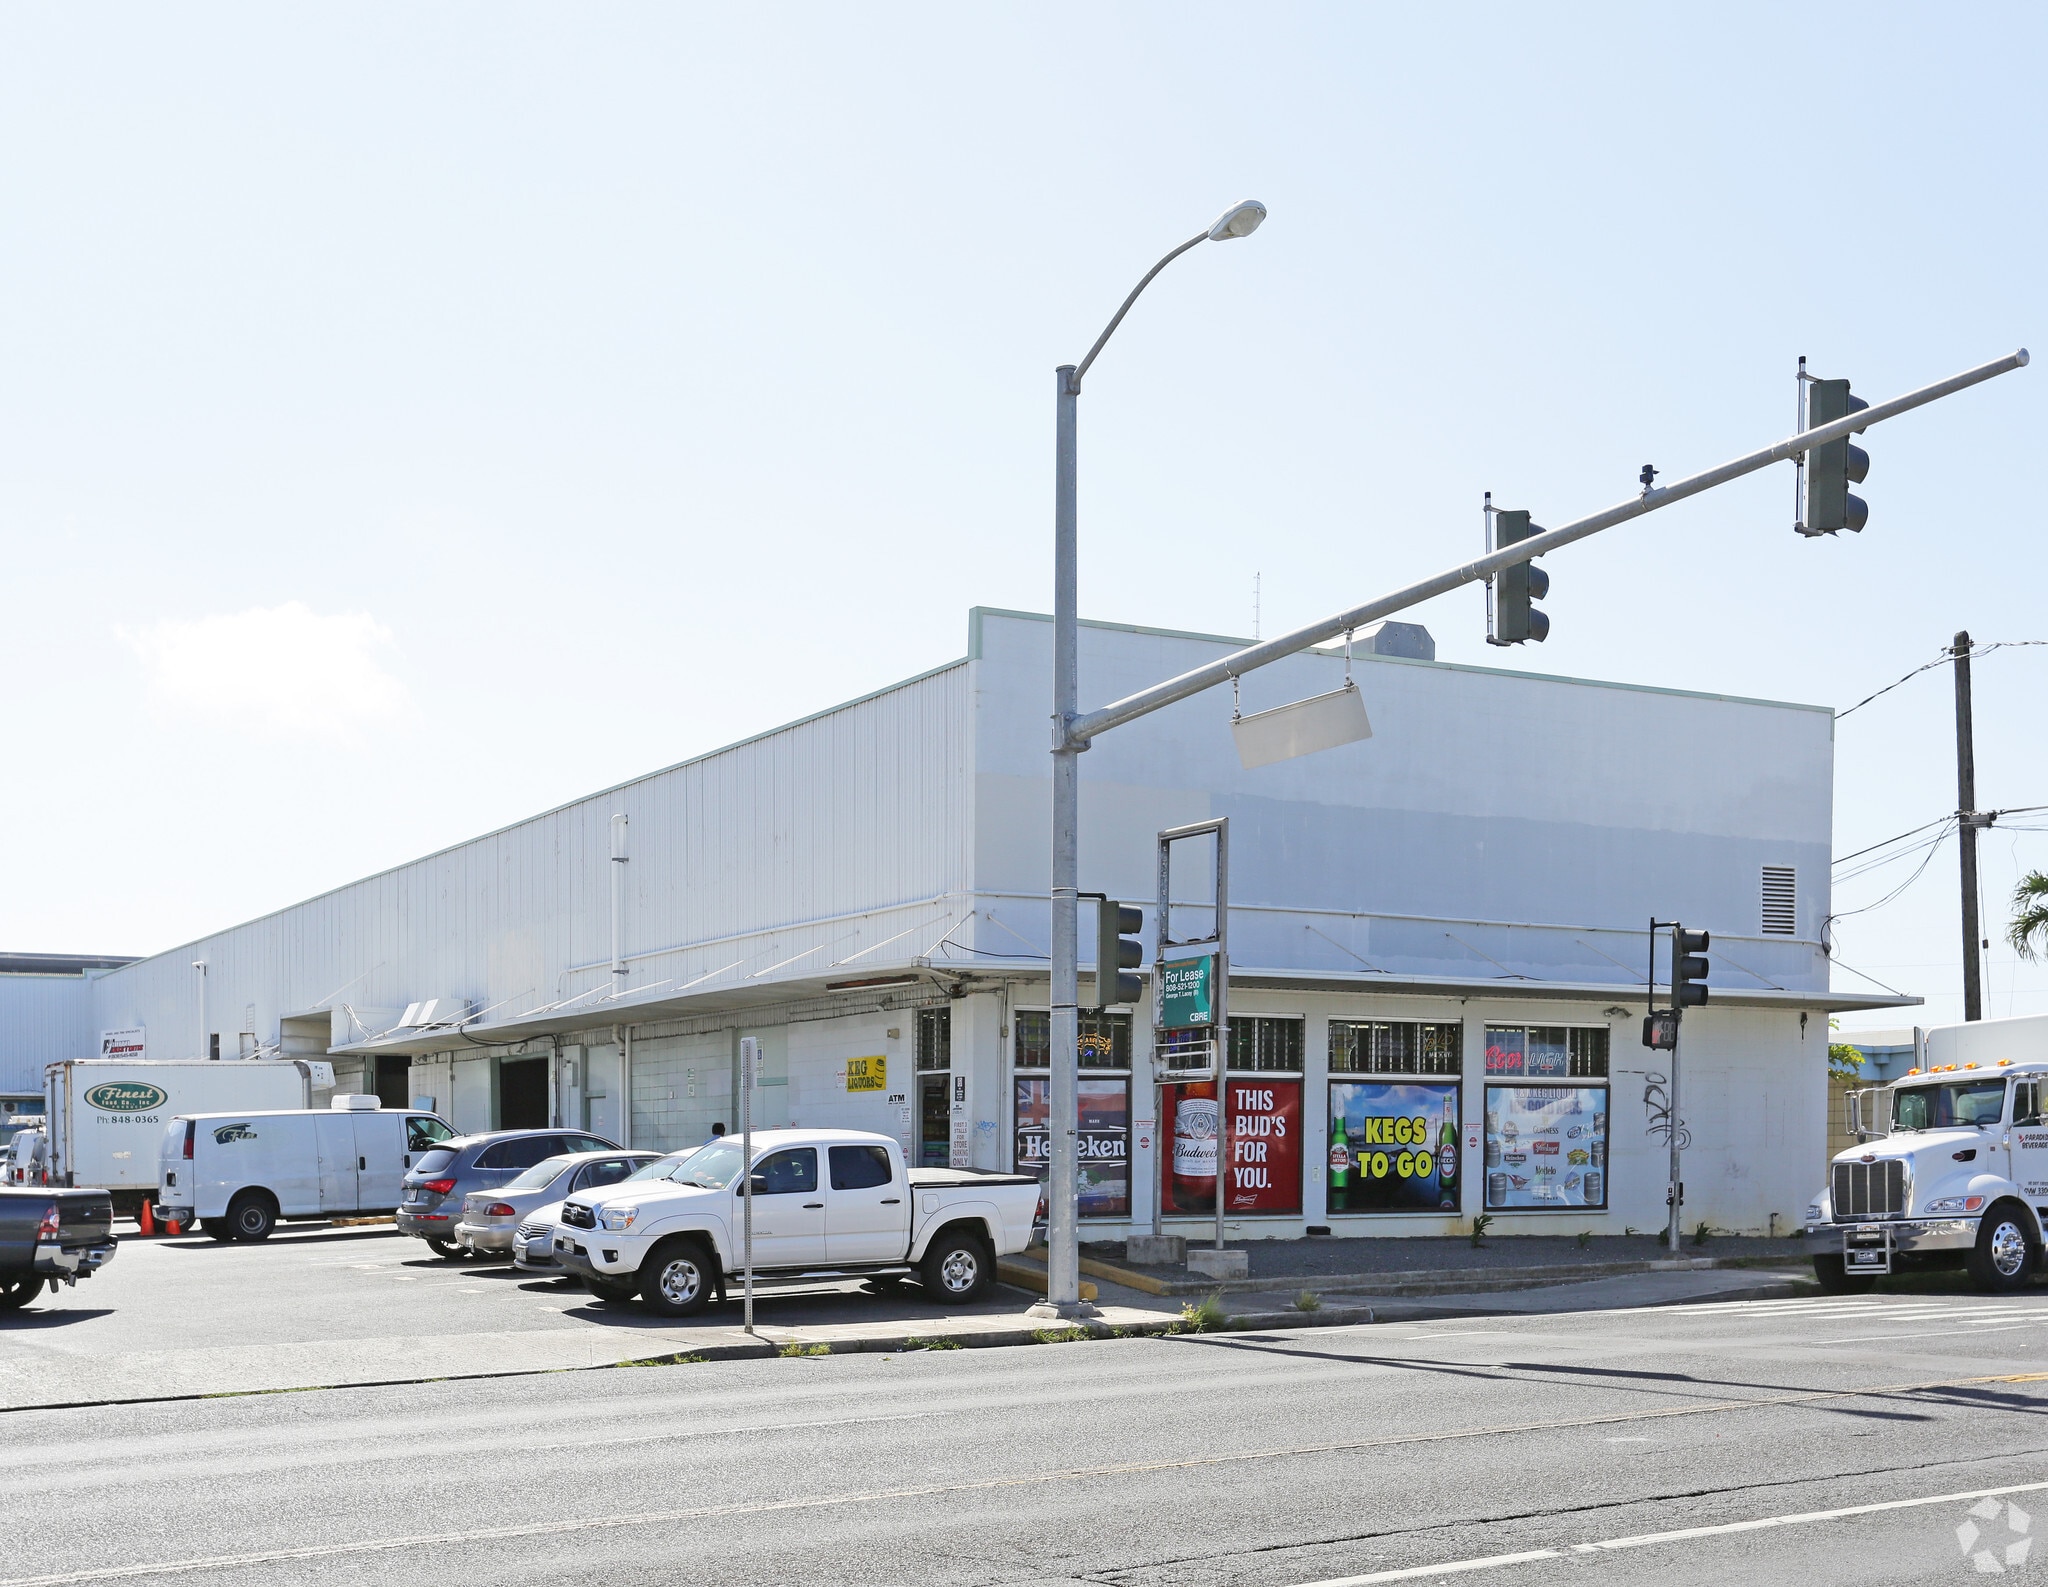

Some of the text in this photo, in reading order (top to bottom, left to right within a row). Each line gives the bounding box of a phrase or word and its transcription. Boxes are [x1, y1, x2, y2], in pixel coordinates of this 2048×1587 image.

[1165, 969, 1204, 984] For Lease
[1165, 980, 1200, 992] 808-521-1200
[1190, 1011, 1208, 1022] CBRE
[1485, 1045, 1523, 1069] Coor
[848, 1060, 868, 1076] KEG
[848, 1076, 875, 1089] LIQUORS
[98, 1087, 153, 1100] Finest
[888, 1094, 905, 1102] ATM
[1235, 1089, 1274, 1111] THIS
[1550, 1088, 1577, 1100] LIQUOR
[111, 1115, 159, 1124] 848-0365
[1235, 1115, 1286, 1137] BUD'S
[1365, 1116, 1427, 1144] KEGS
[1532, 1126, 1559, 1135] GUINNESS
[953, 1141, 968, 1149] STORE
[1025, 1135, 1126, 1157] Heeken
[1234, 1141, 1267, 1162] FOR
[952, 1149, 968, 1157] PARKING
[952, 1158, 968, 1166] ONLY
[1357, 1151, 1433, 1178] TO GO
[1234, 1167, 1272, 1188] YOU.
